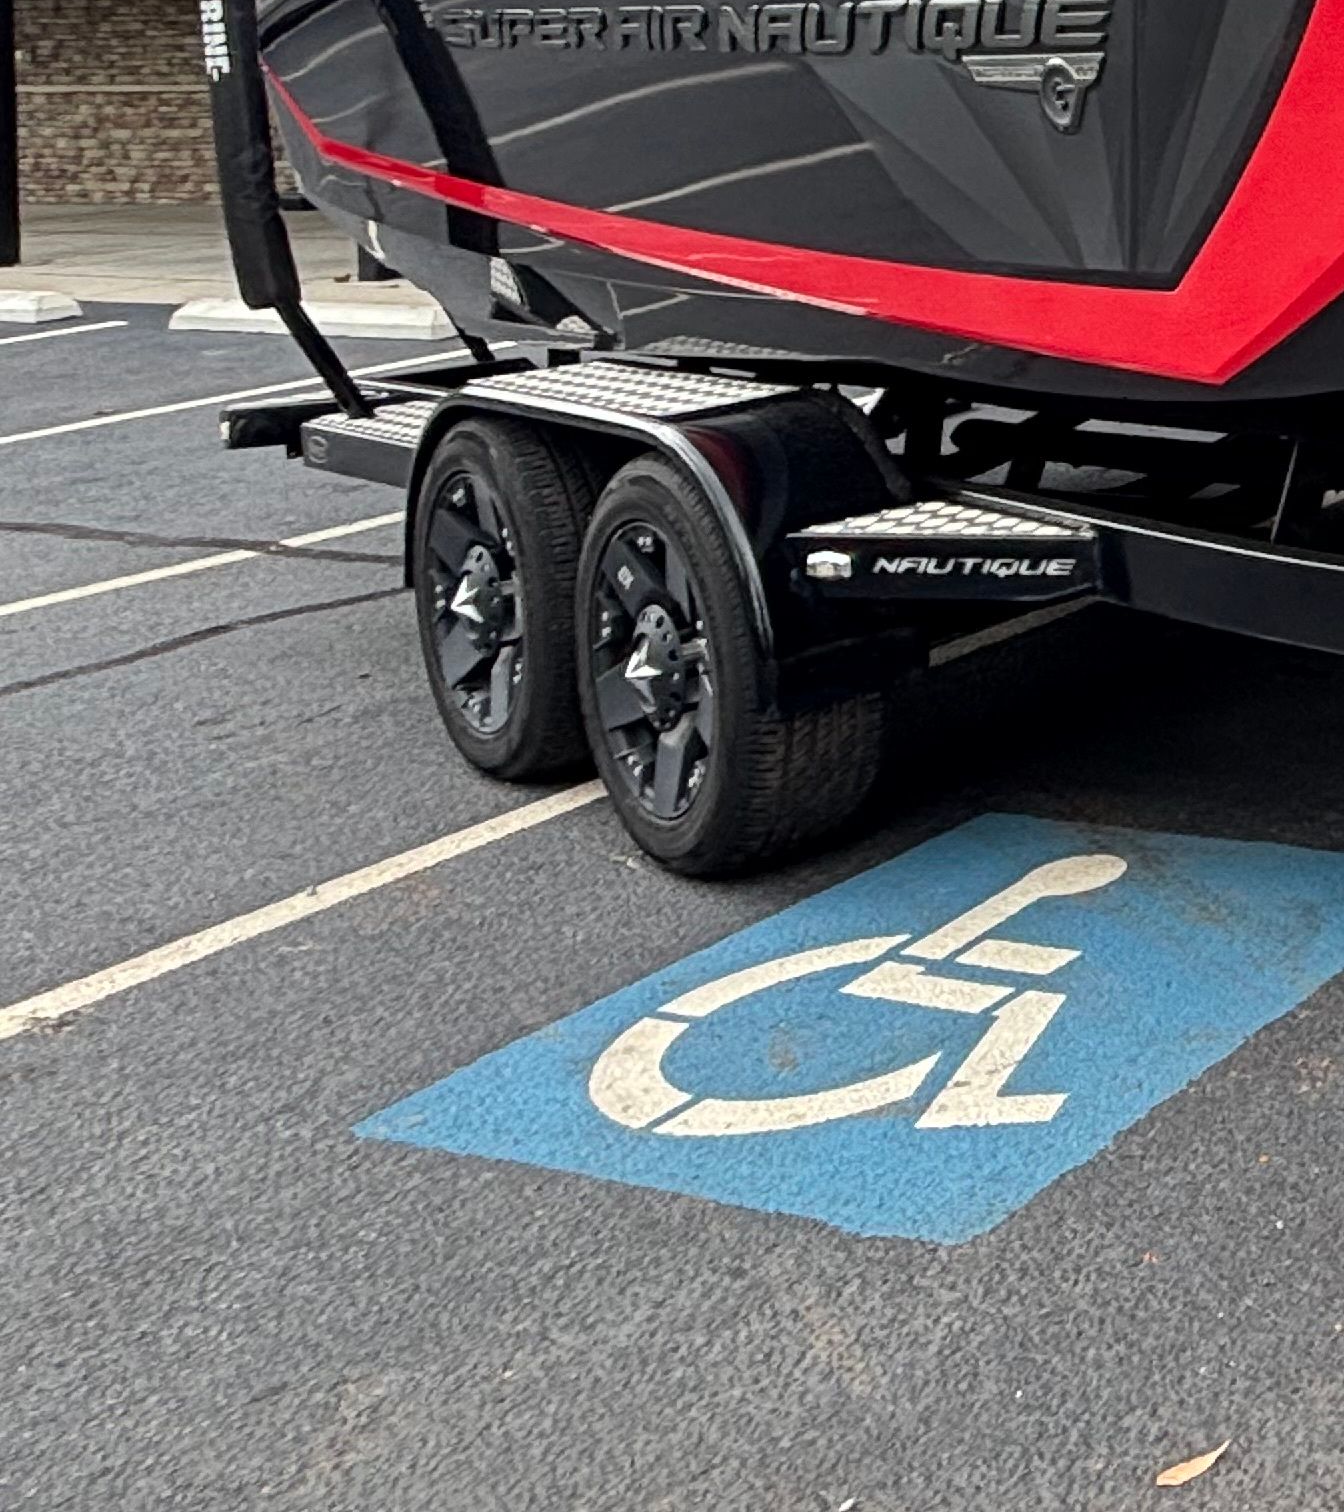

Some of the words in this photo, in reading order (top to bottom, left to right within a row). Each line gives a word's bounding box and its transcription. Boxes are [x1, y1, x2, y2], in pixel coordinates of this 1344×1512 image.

[438, 6, 607, 52] SUPER
[608, 3, 709, 53] AIR
[872, 556, 1077, 578] NAUTIQUE
